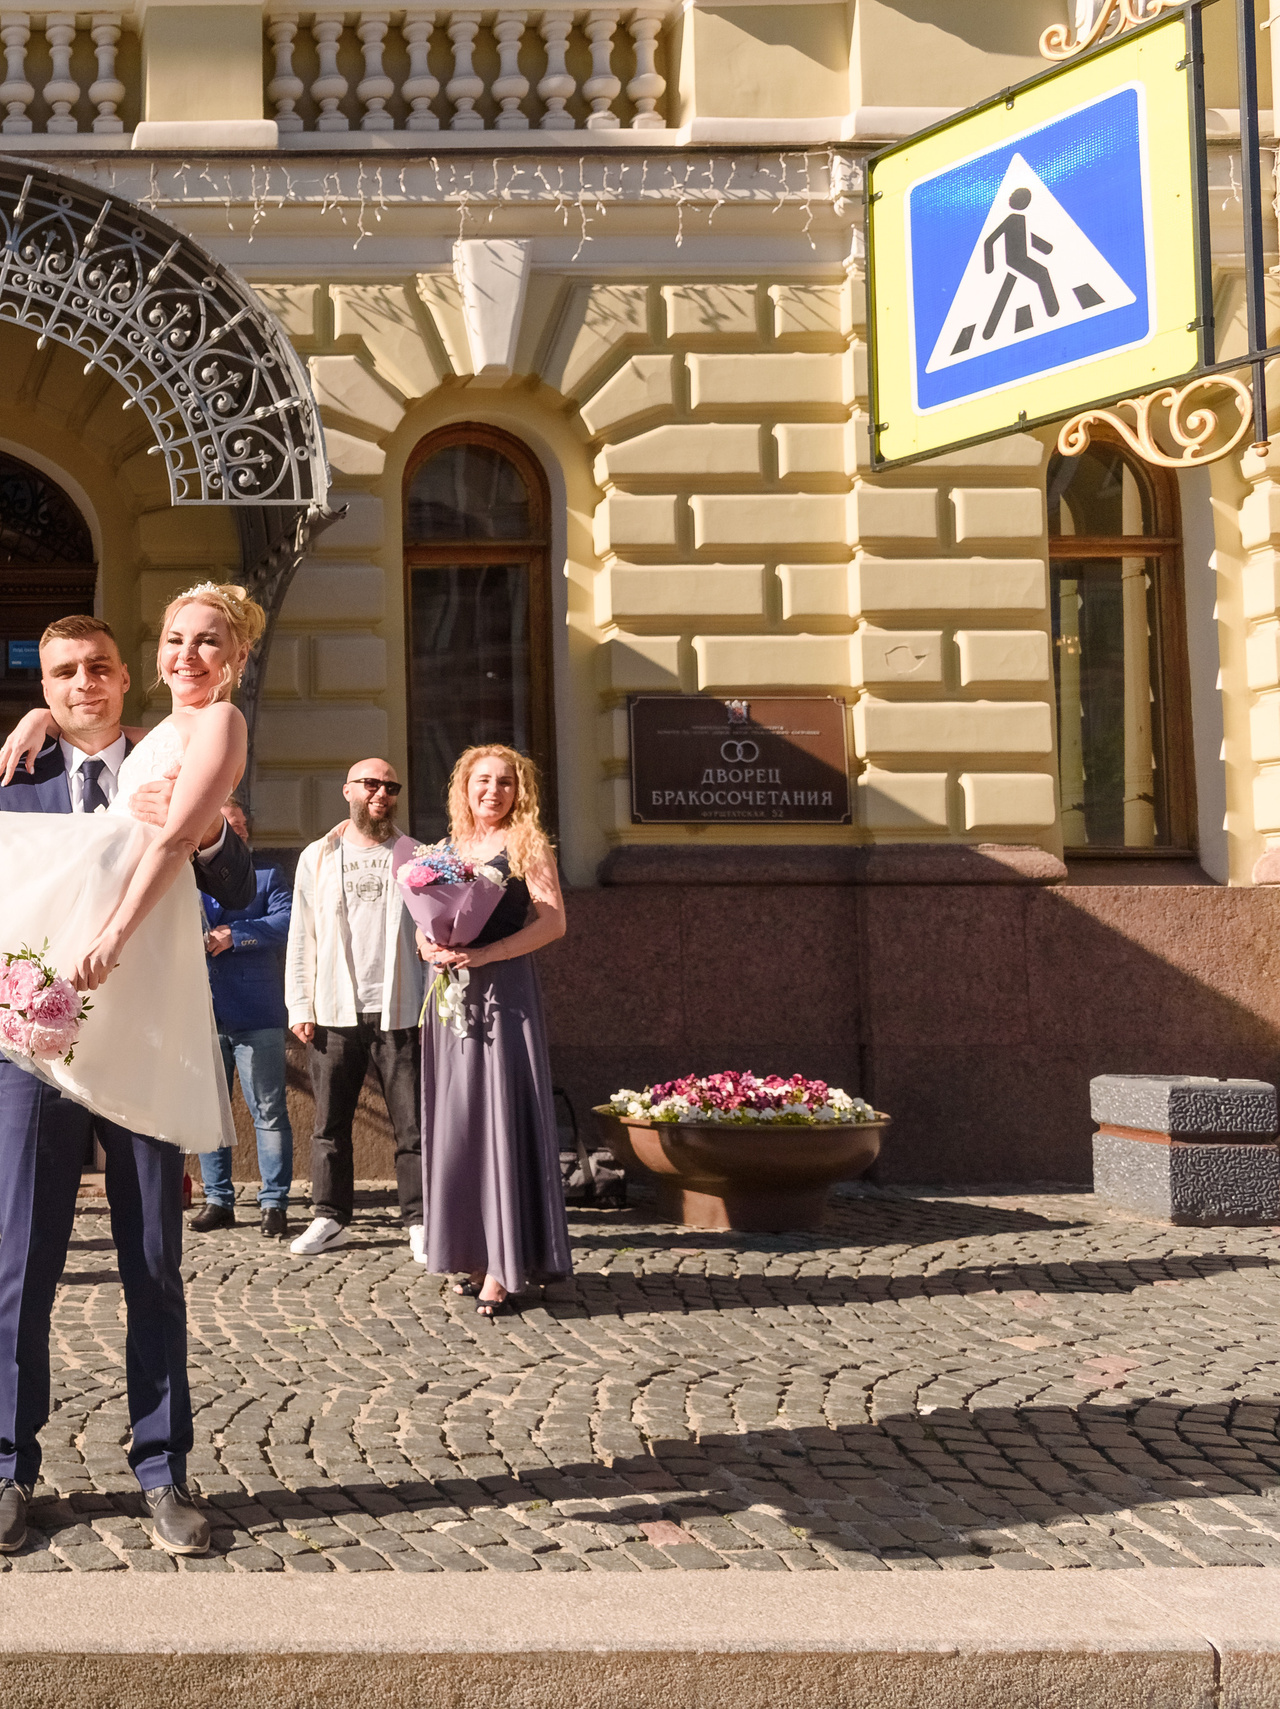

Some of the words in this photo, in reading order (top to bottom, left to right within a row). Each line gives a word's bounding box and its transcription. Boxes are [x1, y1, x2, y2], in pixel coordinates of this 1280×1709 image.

[701, 769, 781, 785] ДВОРЕЦ
[651, 790, 833, 806] БРАКОСОЧЕТАНИЯ
[343, 861, 359, 873] OM
[363, 859, 389, 869] TAIL
